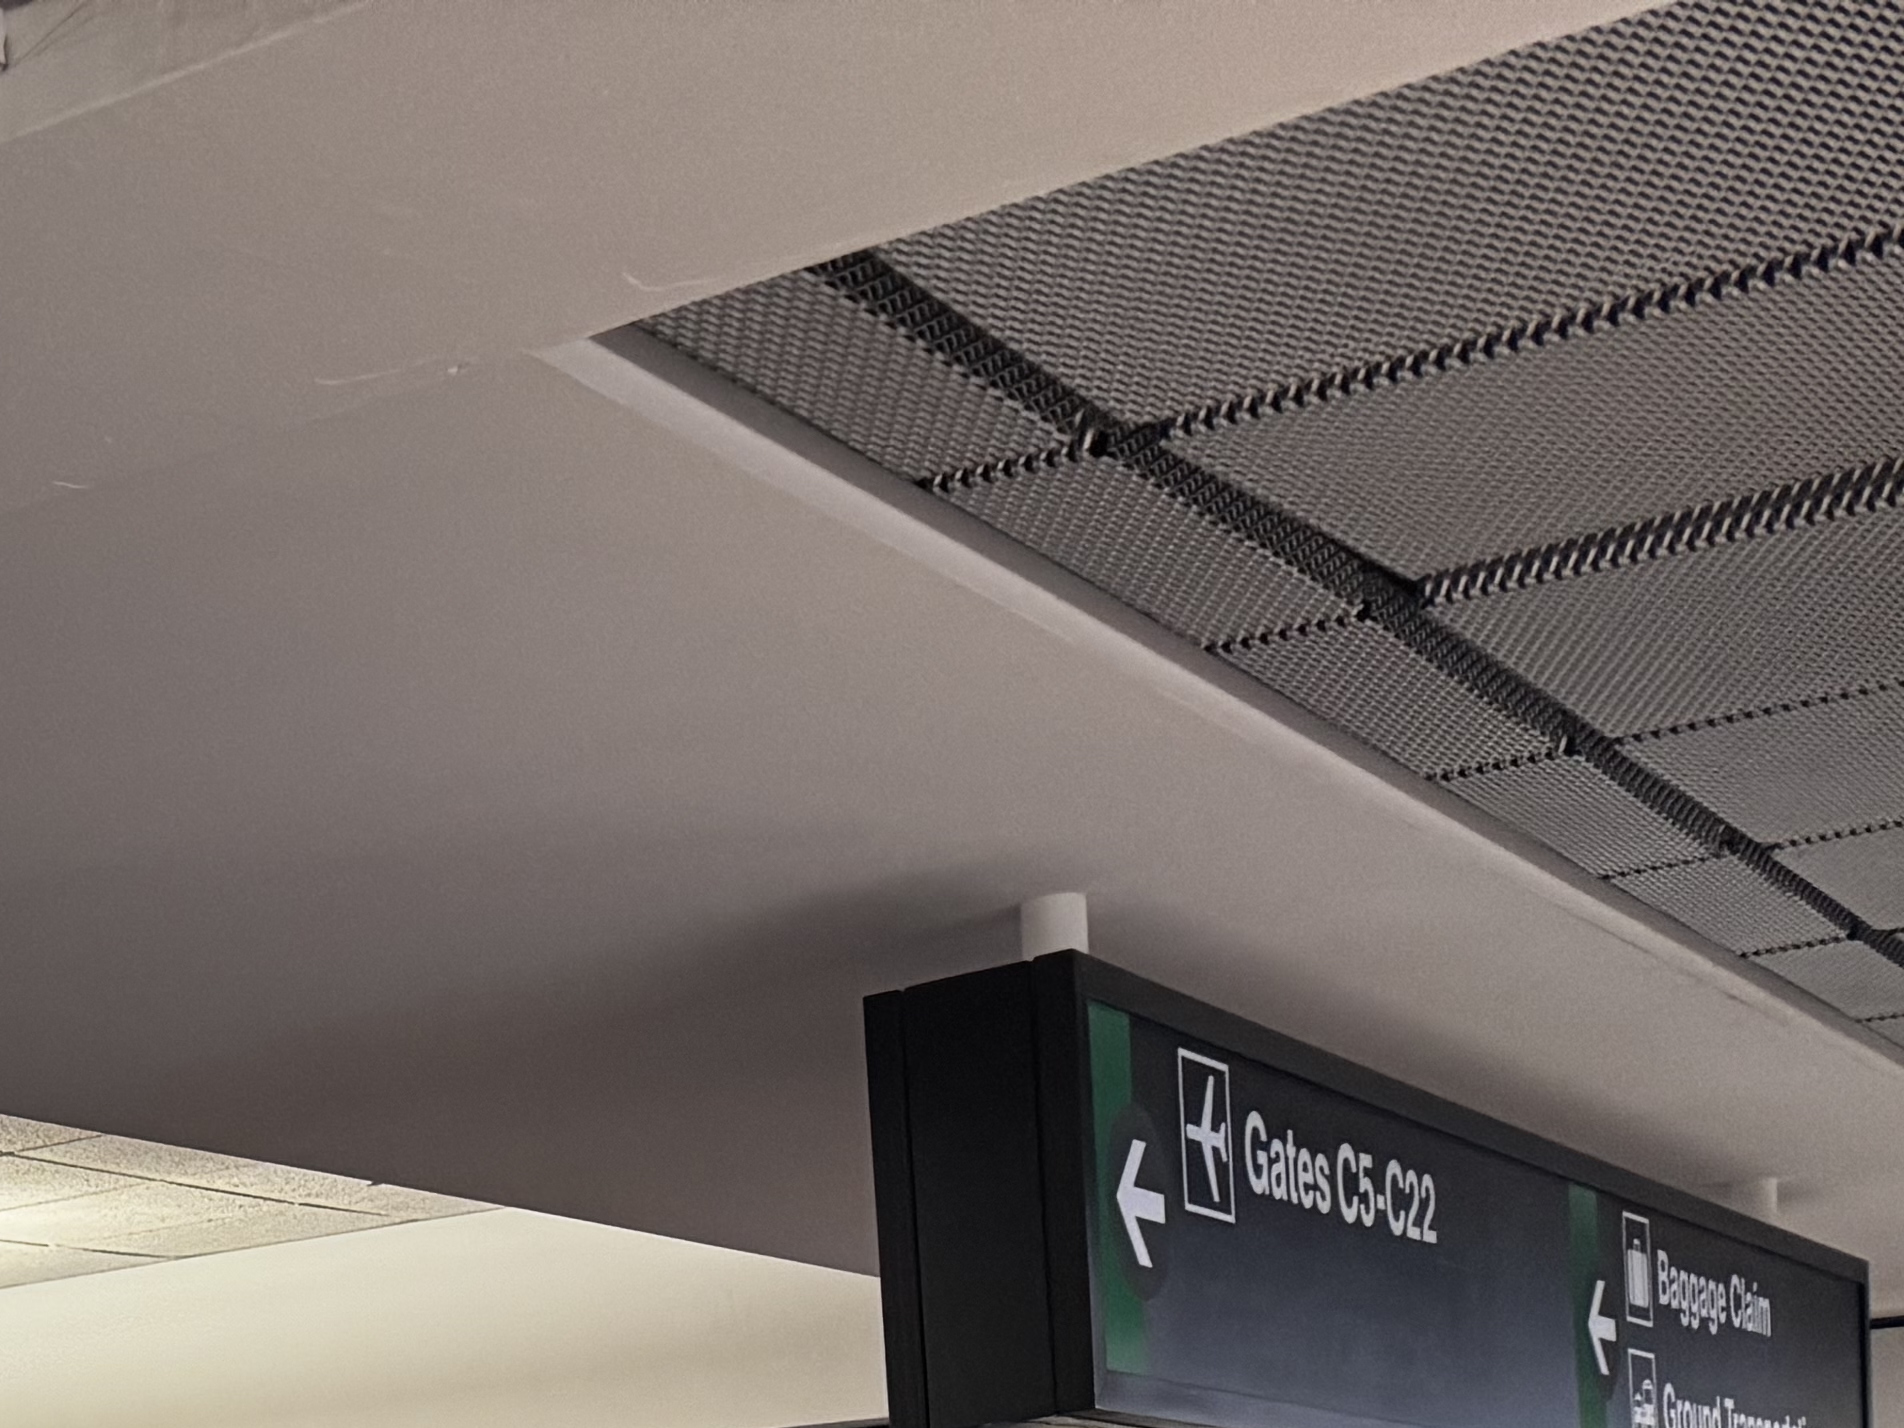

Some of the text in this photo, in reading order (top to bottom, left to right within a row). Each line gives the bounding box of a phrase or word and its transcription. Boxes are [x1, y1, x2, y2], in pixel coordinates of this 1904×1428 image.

[1245, 1110, 1438, 1244] Gates C5-C22
[1657, 1249, 1772, 1338] Baggage Claim
